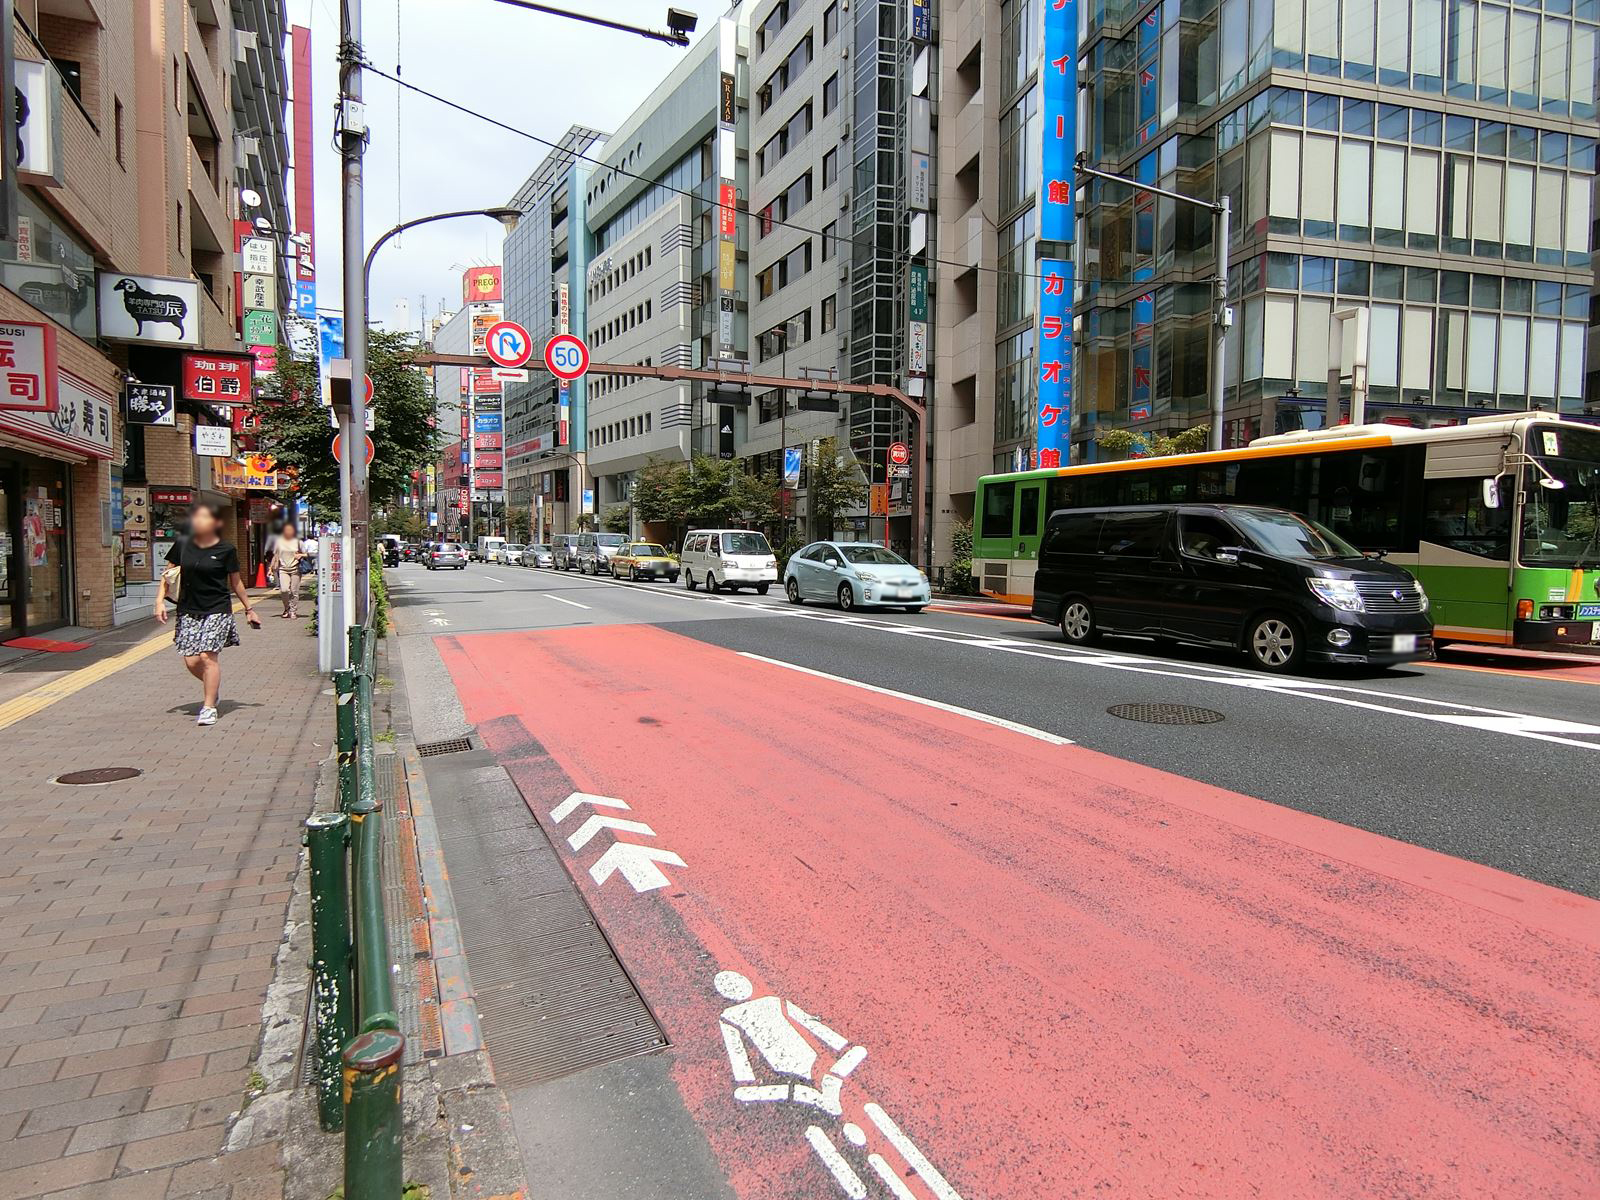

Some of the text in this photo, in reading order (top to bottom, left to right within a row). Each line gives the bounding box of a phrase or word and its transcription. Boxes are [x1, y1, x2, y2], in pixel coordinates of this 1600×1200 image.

[250, 242, 267, 250] はり
[250, 254, 268, 262] 指圧
[472, 278, 500, 287] PREGO
[165, 301, 183, 318] 辰
[300, 294, 313, 309] P
[555, 346, 579, 367] 50
[194, 360, 240, 373] 珈琲
[1040, 272, 1064, 468] カラオケ館
[194, 375, 240, 396] 伯爵
[330, 542, 341, 593] 駐停車禁止
